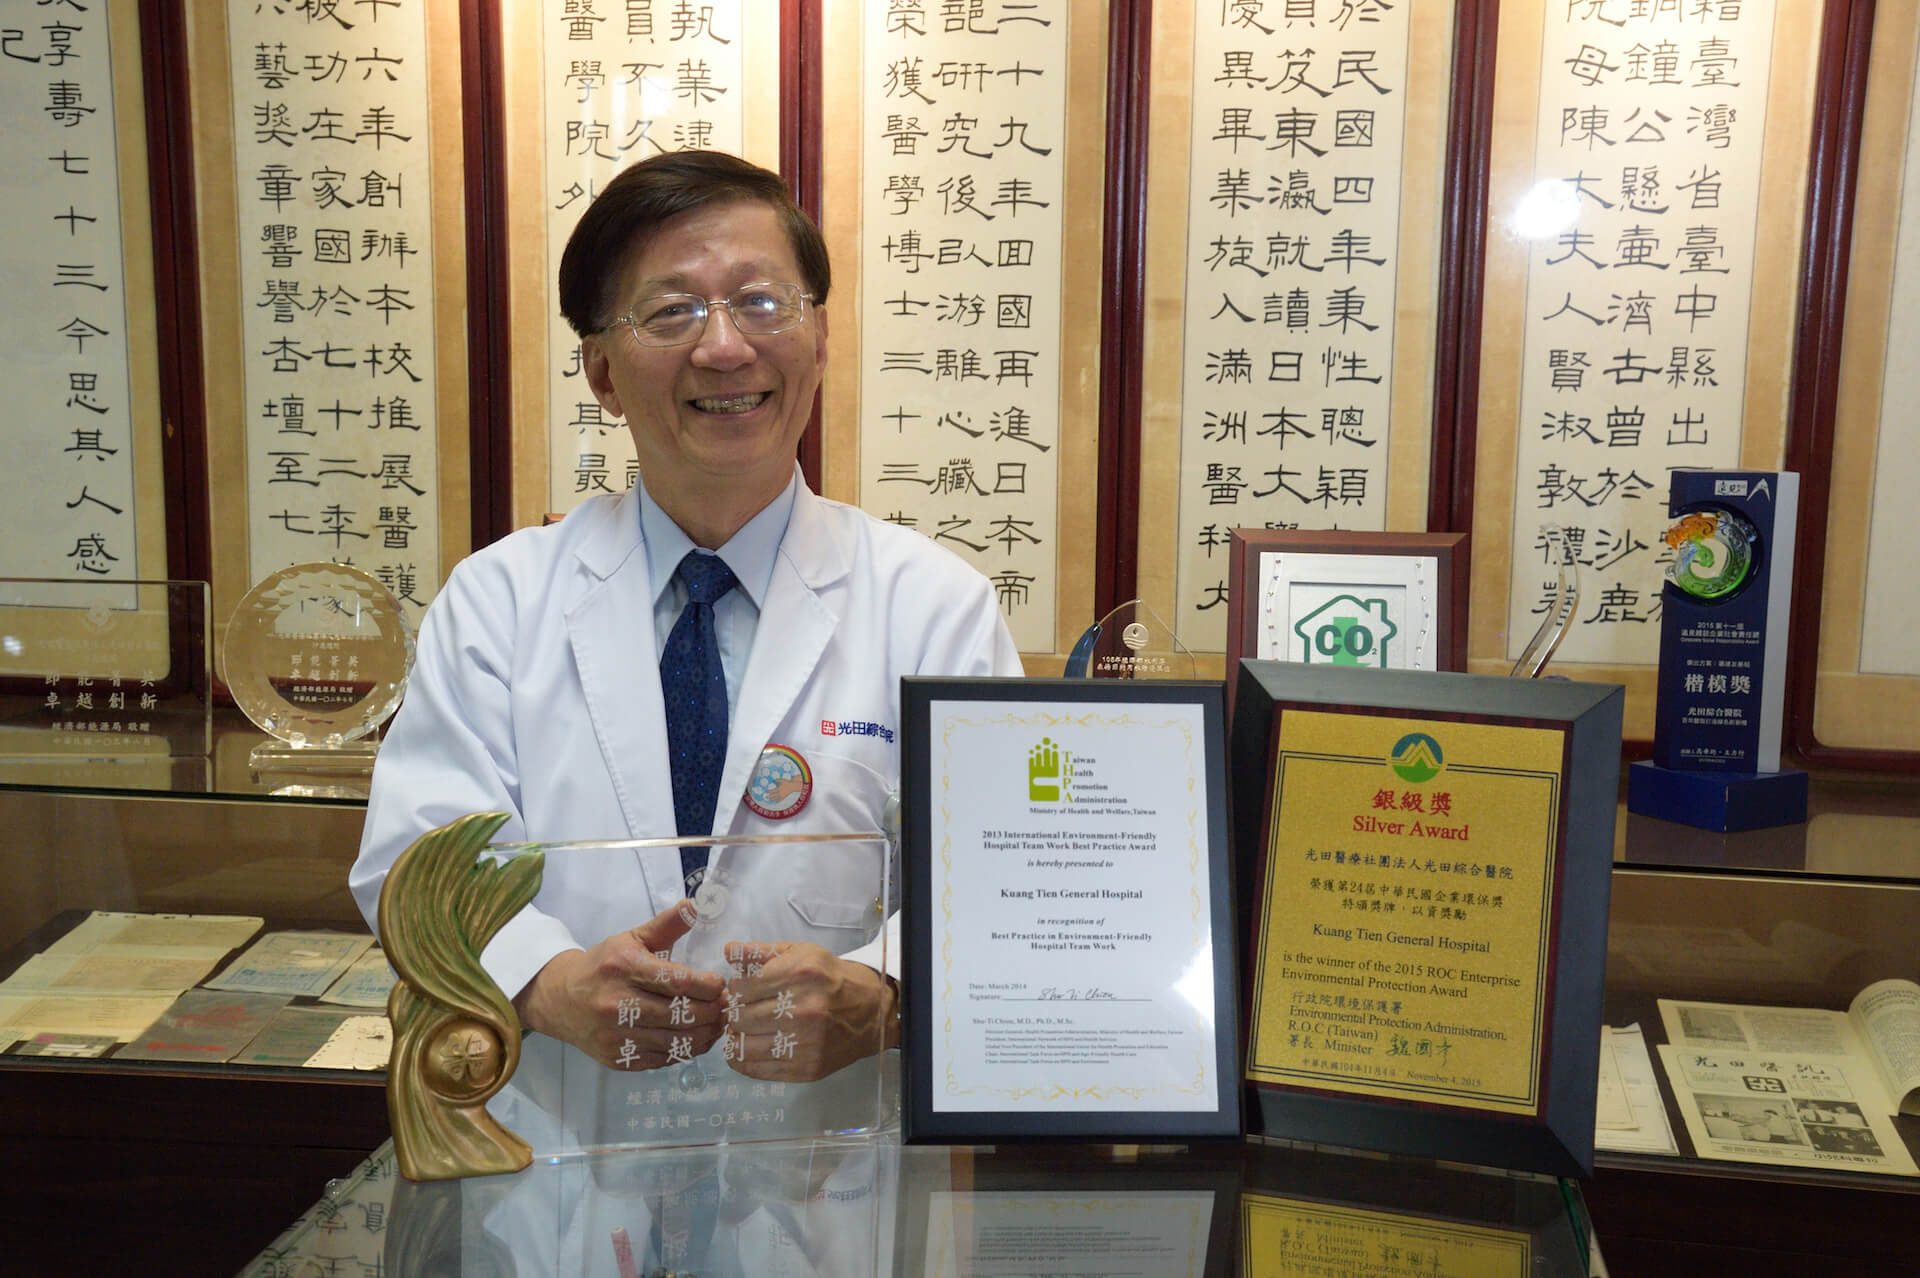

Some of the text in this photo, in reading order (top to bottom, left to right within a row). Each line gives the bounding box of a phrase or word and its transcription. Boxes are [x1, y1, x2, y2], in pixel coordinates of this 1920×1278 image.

[253, 0, 321, 536] 藝獎章響譽杏壇至七
[1312, 0, 1395, 530] 於民國四年秉性聰穎
[1684, 674, 1750, 694] 楷模獎
[1372, 788, 1452, 817] 銀級獎
[982, 831, 1156, 841] 2013 International Environment-Friendly
[1353, 816, 1469, 841] Silver Award
[984, 841, 1020, 851] Hospital
[1046, 842, 1070, 850] Work
[1072, 842, 1090, 850] Best
[1128, 843, 1156, 851] Award
[1036, 860, 1062, 869] hereby
[1064, 860, 1104, 869] presented
[1000, 889, 1143, 900] Kuang Tien General Hospital
[1047, 918, 1094, 927] recognition
[1096, 918, 1106, 926] of
[991, 932, 1009, 940] Best
[1058, 933, 1152, 943] Environment-Friendly
[1031, 942, 1067, 951] Hospital
[1312, 923, 1490, 954] Kuang Tien General Hospital
[1283, 951, 1520, 987] is the winner of the 2015 ROC Enterprise
[1282, 968, 1468, 999] Environmental Protection Award
[616, 992, 797, 1028] 節能菁英
[1290, 1005, 1366, 1024] Environmental
[1368, 1013, 1422, 1032] Protection
[1327, 1024, 1379, 1041] (Taiwan)
[615, 1029, 798, 1069] 卓越創新
[1325, 1038, 1373, 1055] Minister
